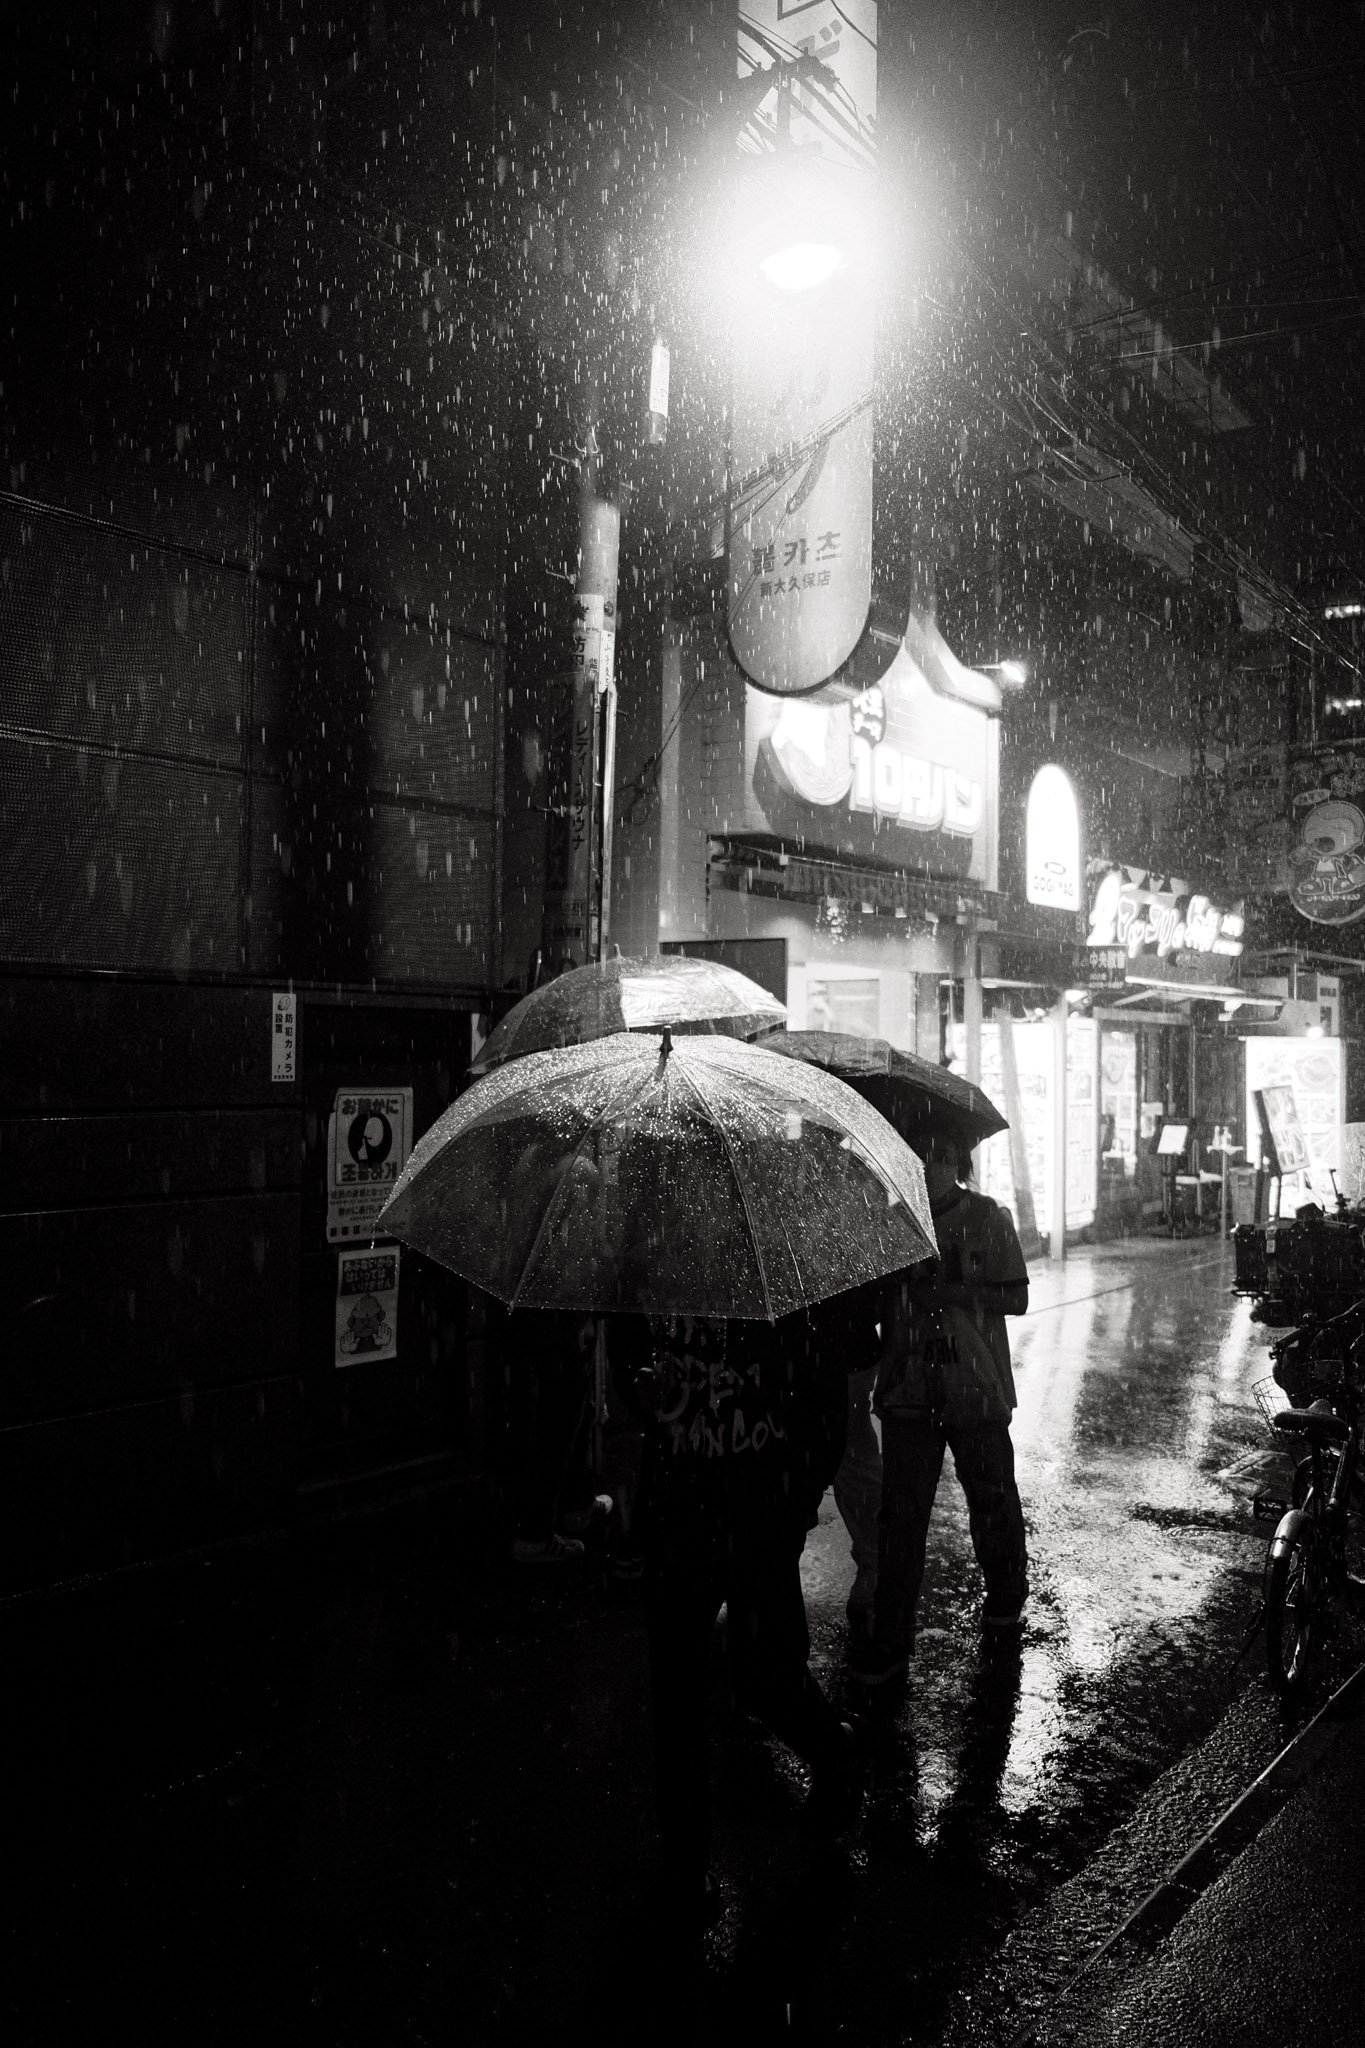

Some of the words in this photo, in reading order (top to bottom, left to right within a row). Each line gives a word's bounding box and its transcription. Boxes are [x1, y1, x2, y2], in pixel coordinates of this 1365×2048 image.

[760, 569, 832, 598] 新大久保店
[285, 1013, 293, 1073] 防犯カメラ
[331, 1187, 393, 1200] 住民の迷惑となって
[343, 1256, 394, 1273] あぶないから
[345, 1268, 387, 1283] はいっては
